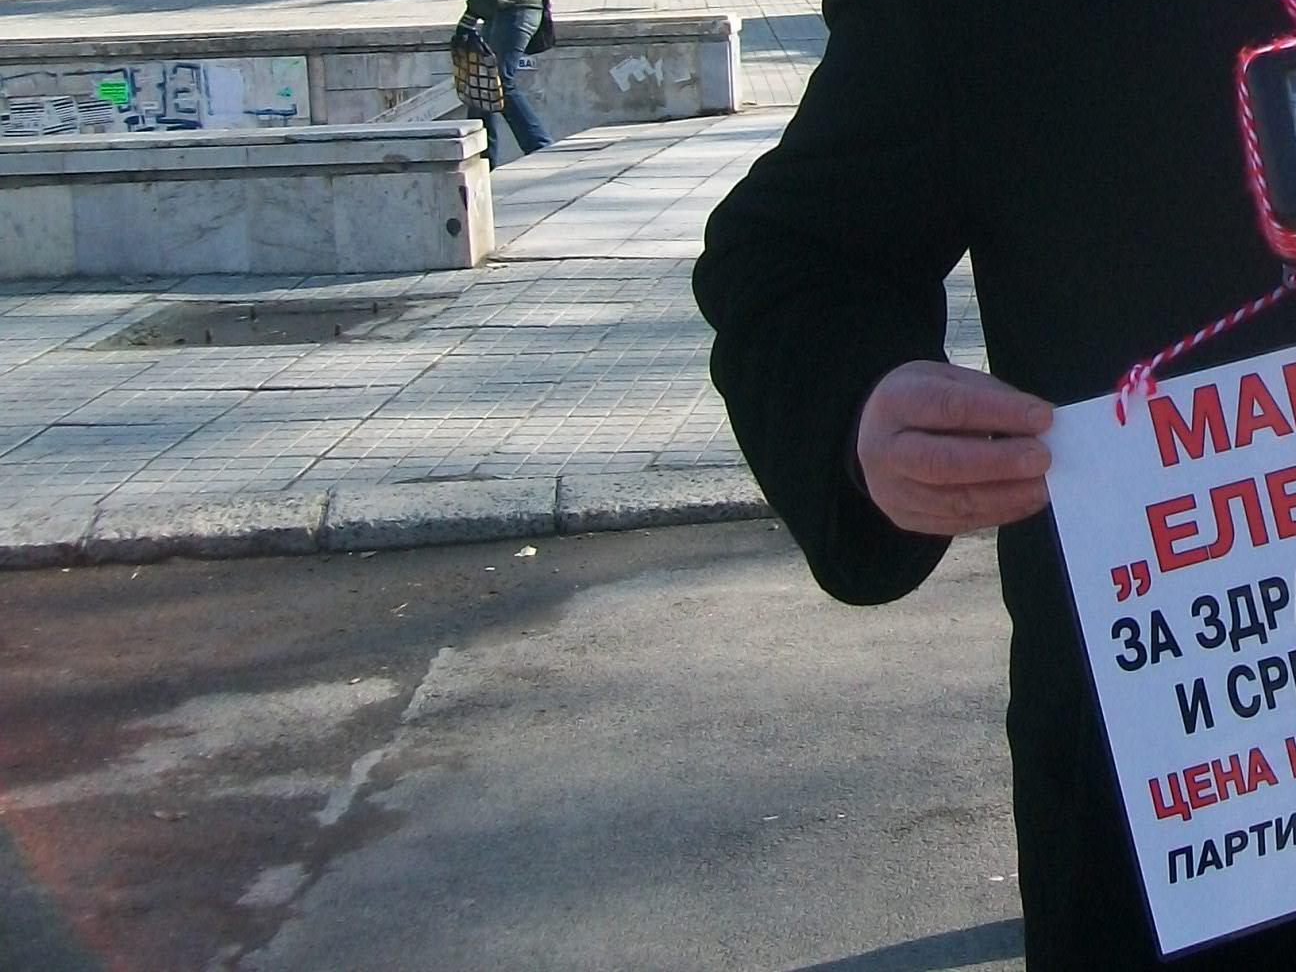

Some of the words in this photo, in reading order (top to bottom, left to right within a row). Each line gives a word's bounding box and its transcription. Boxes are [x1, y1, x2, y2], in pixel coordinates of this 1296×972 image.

[1111, 609, 1183, 672] ЗА
[1175, 677, 1215, 734] И
[1149, 747, 1279, 821] ЦЕНА
